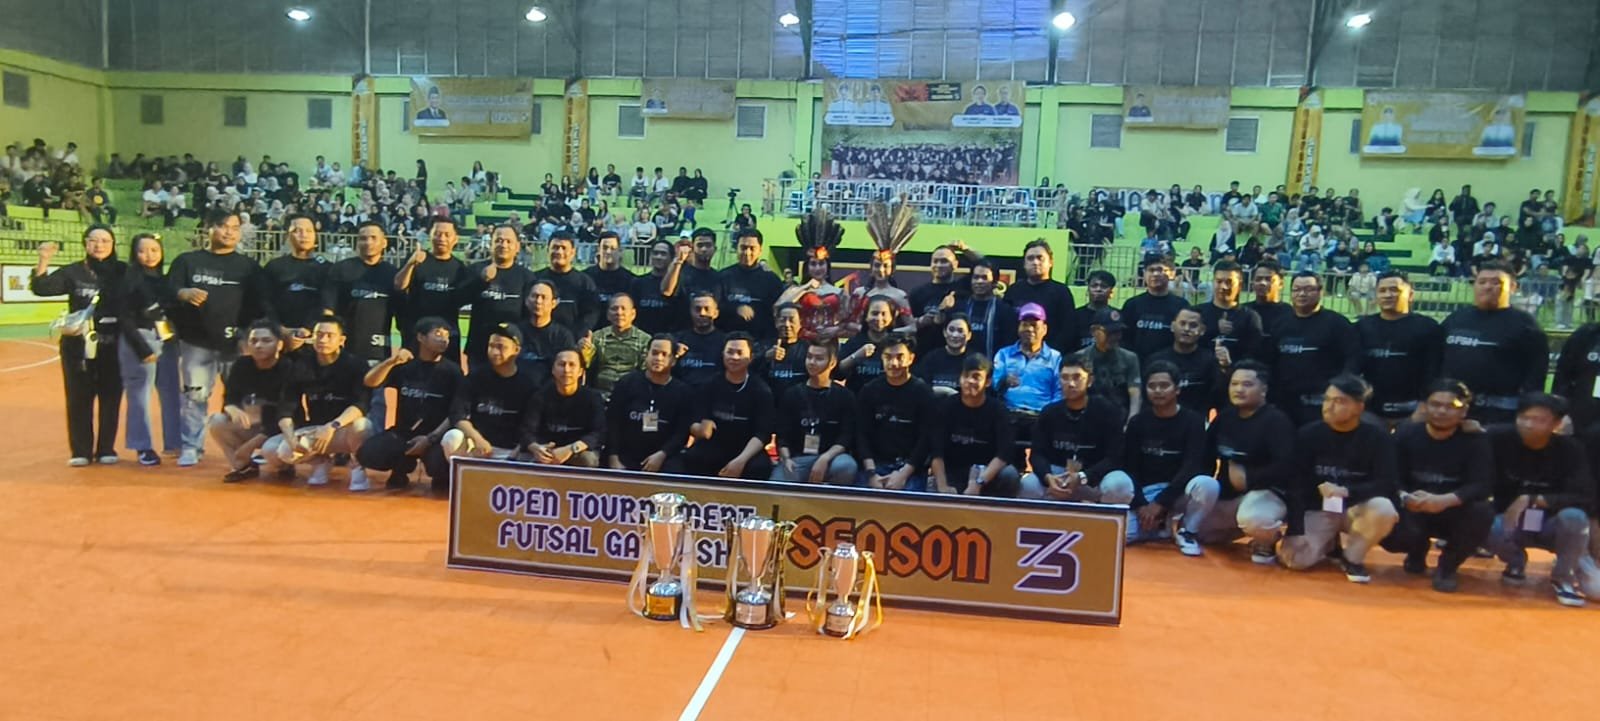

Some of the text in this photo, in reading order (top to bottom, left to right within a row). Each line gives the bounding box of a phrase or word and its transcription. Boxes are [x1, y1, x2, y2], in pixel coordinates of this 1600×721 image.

[490, 486, 756, 534] OPEN TOURNMENT
[498, 519, 598, 556] FUTSAL
[786, 515, 992, 584] SEASON
[1014, 527, 1083, 594] 3
